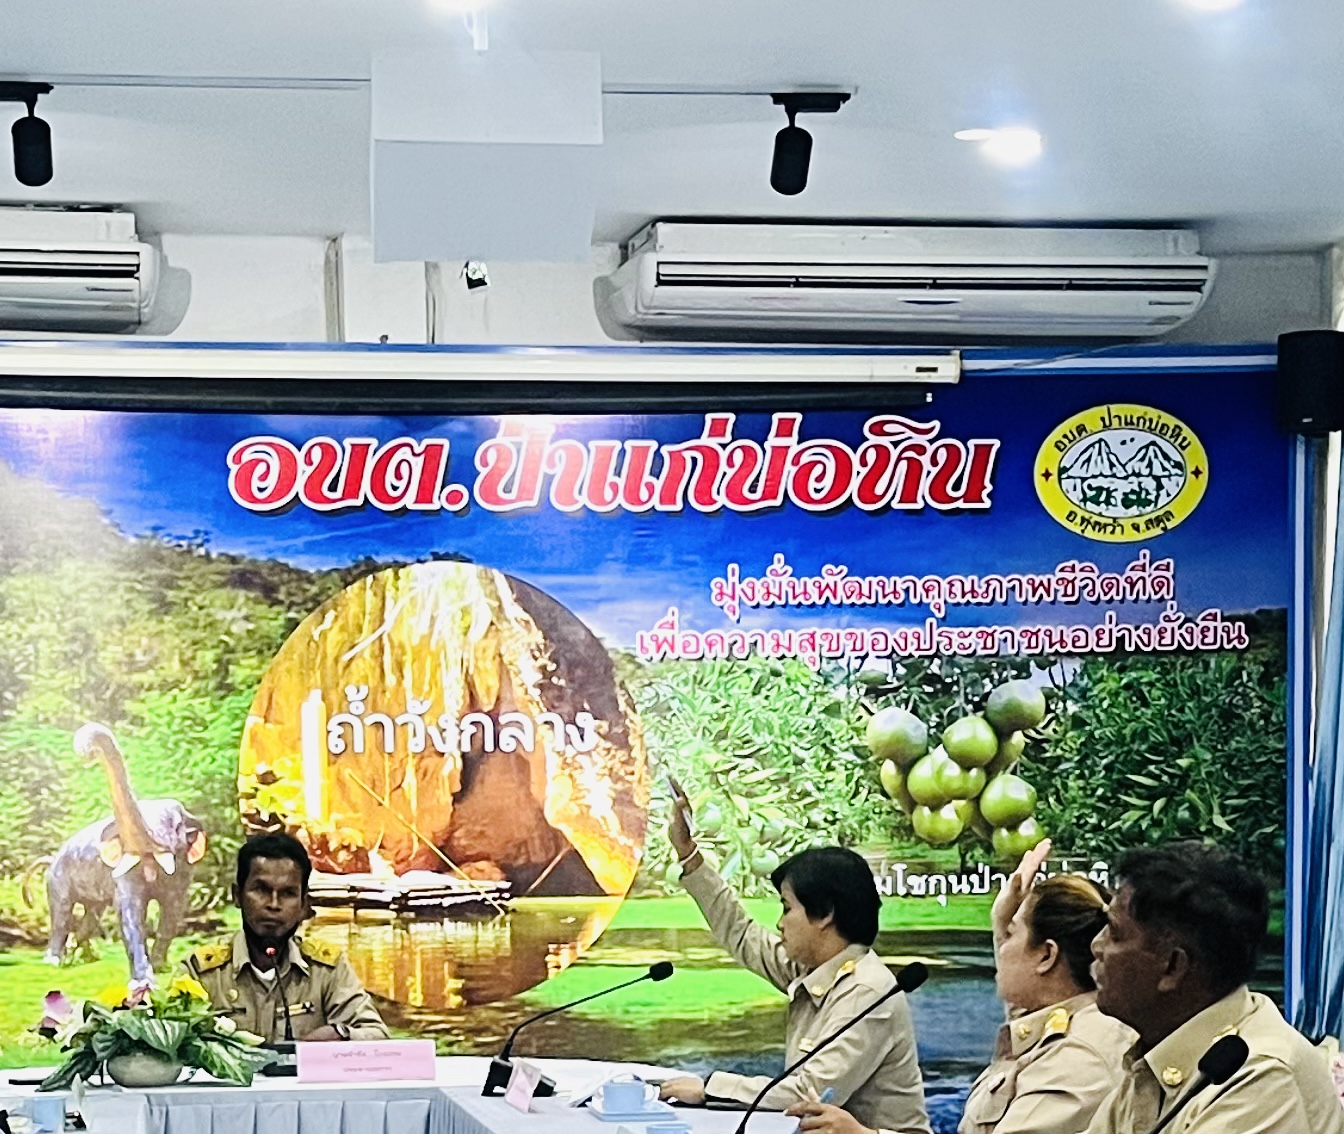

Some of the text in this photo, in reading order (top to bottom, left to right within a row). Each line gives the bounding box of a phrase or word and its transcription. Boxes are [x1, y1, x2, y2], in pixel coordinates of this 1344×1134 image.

[227, 413, 1000, 511] อบต.ป่าแก่บ่อหิน
[711, 549, 1173, 618] มุ่งมั่นพัฒนาคุณภาพชีวิตที่ดี
[636, 602, 1249, 667] เพื่อความสุขของประชาชนอย่างยั่งยืน
[327, 685, 600, 754] ถ้ำวังกลาง
